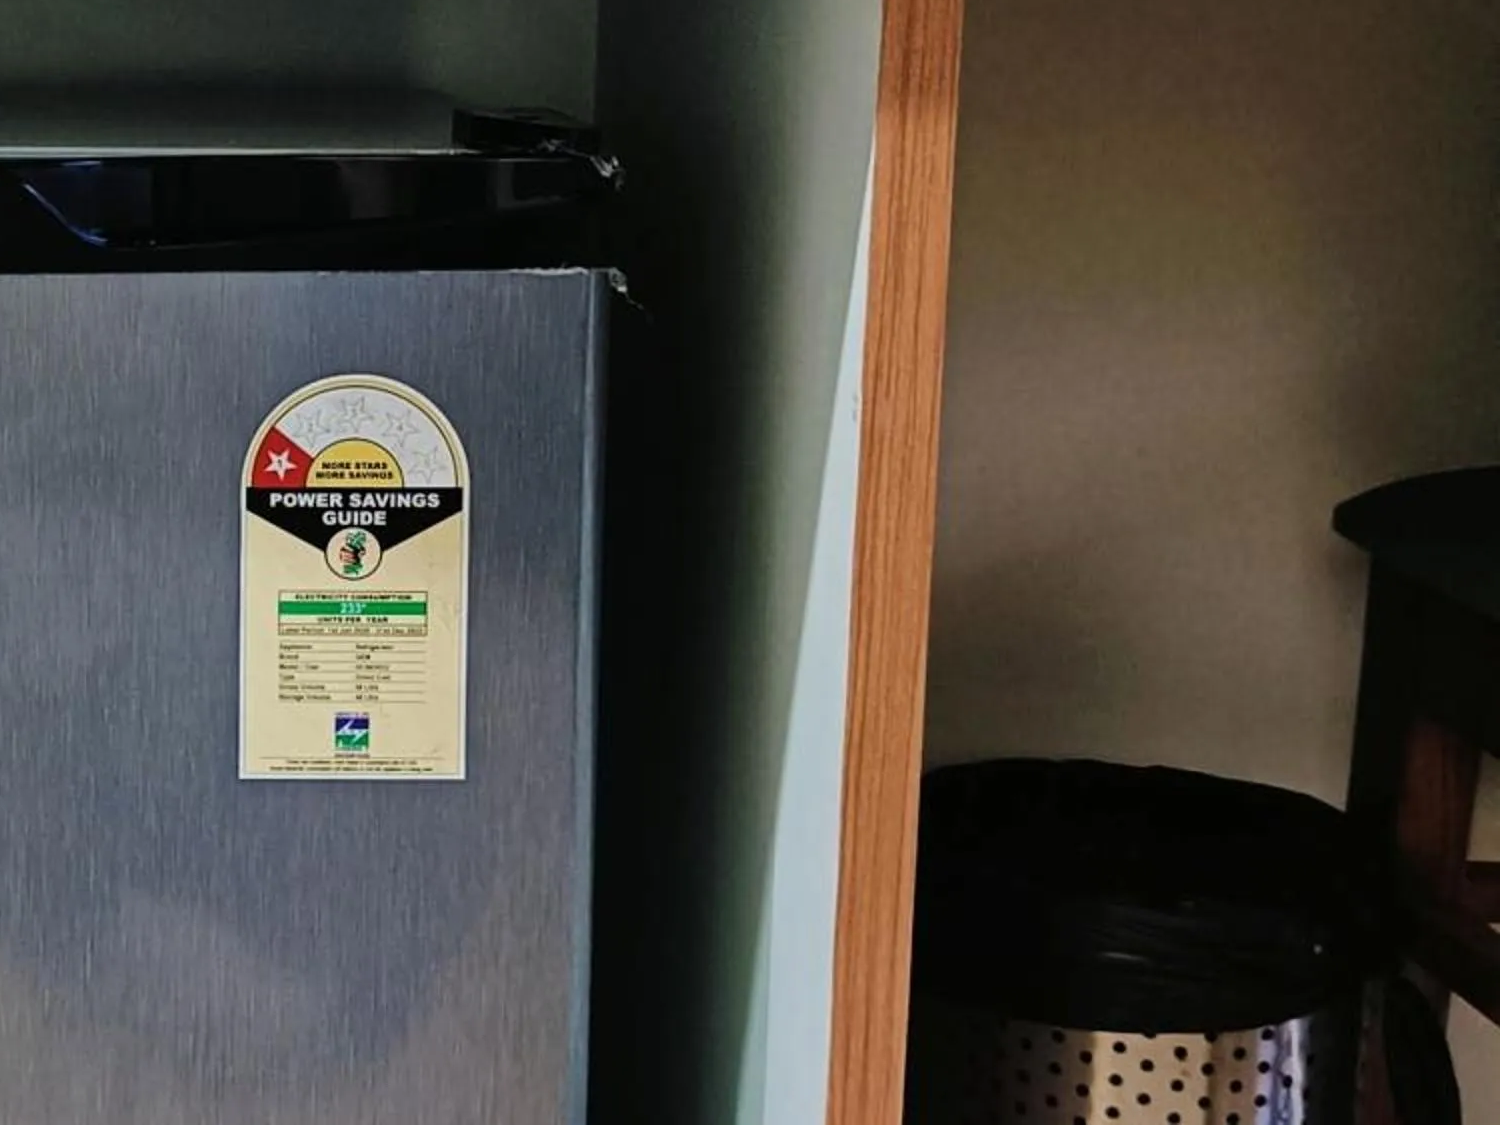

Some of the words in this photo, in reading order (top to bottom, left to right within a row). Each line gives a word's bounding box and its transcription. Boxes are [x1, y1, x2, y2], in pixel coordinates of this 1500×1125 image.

[321, 461, 351, 470] MORE
[355, 461, 388, 470] STARS
[315, 471, 345, 480] MORE
[349, 471, 393, 480] SAVINGS
[269, 492, 344, 508] POWER
[349, 492, 441, 508] SAVINGS
[322, 510, 387, 526] GUIDE
